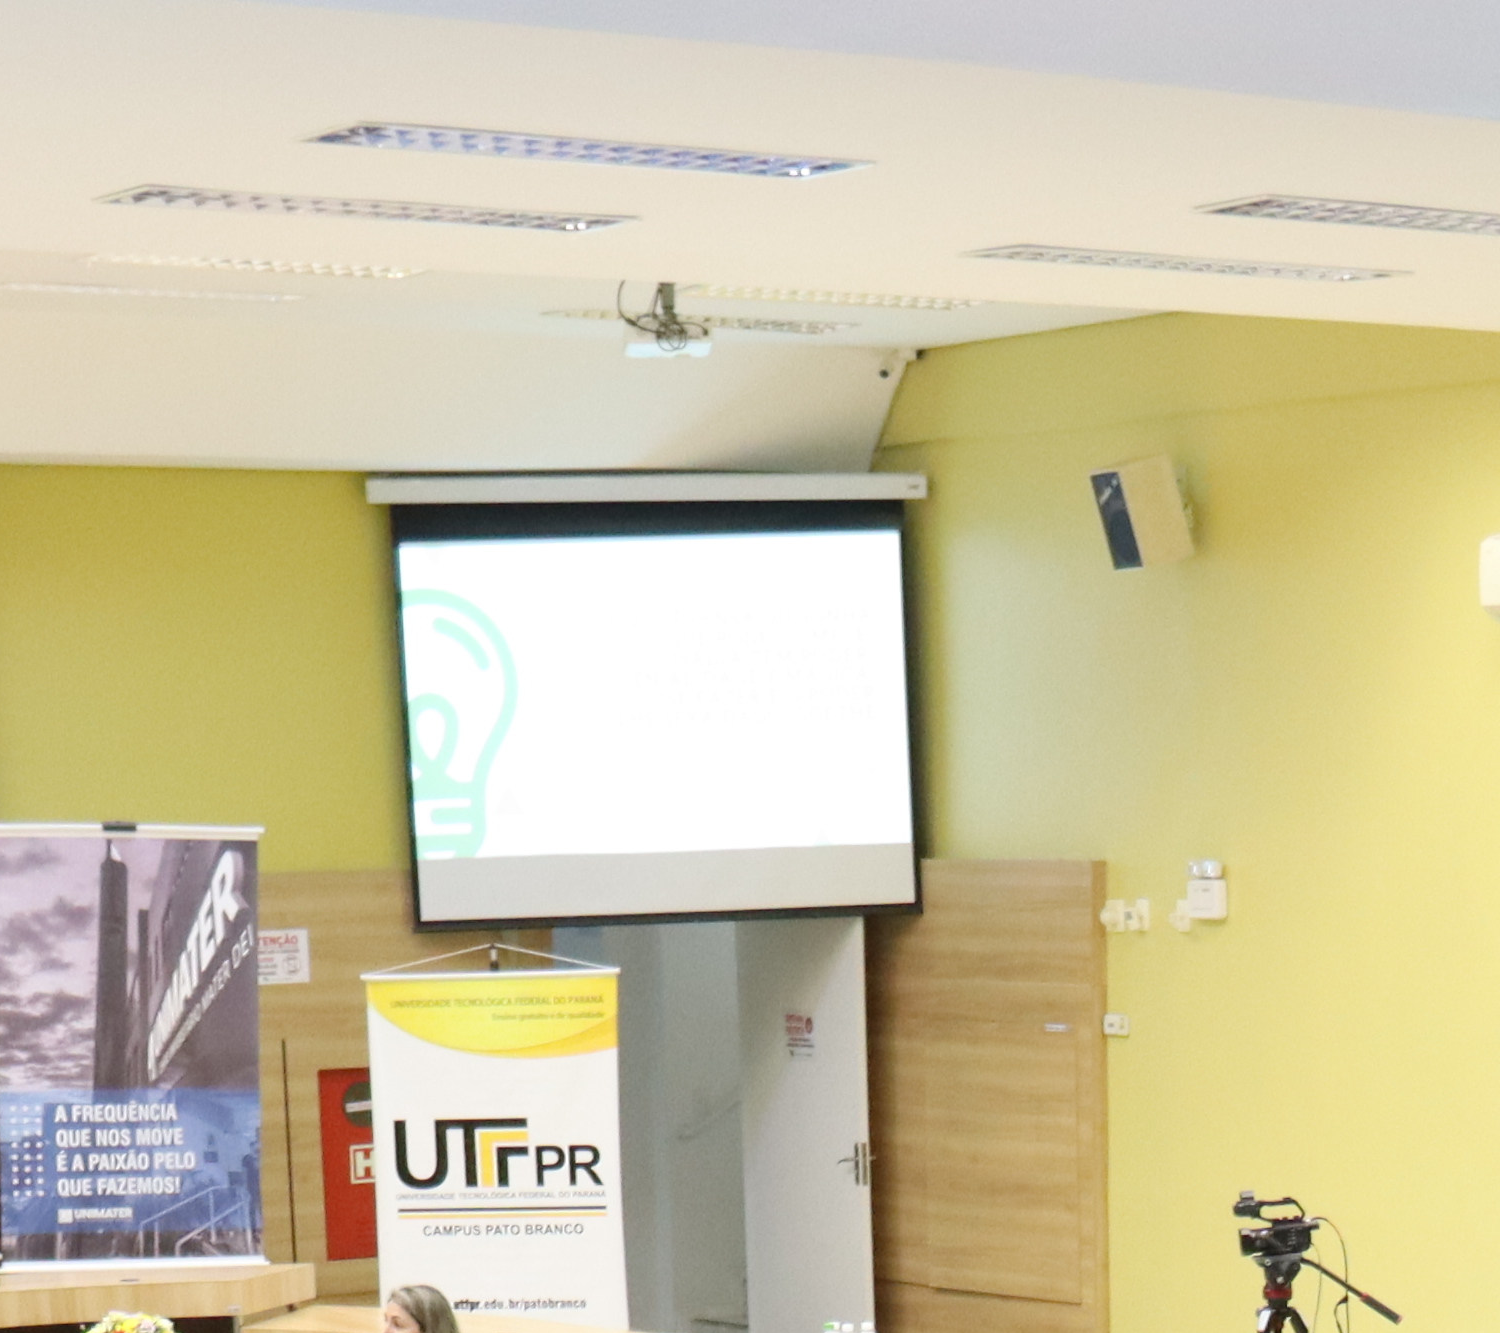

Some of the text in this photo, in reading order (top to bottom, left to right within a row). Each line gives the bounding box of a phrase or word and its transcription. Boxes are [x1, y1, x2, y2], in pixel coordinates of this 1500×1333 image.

[231, 923, 255, 970] DEI
[54, 1100, 178, 1124] A FREQUÊNCIA
[55, 1127, 184, 1149] QUE NOS MOVE
[56, 1149, 196, 1173] É A PAIXÃO PELO
[57, 1176, 182, 1198] QUE FAZEMOS!
[73, 1206, 134, 1220] UNIMATER
[423, 1222, 585, 1237] CAMPUS PATO BRANCO
